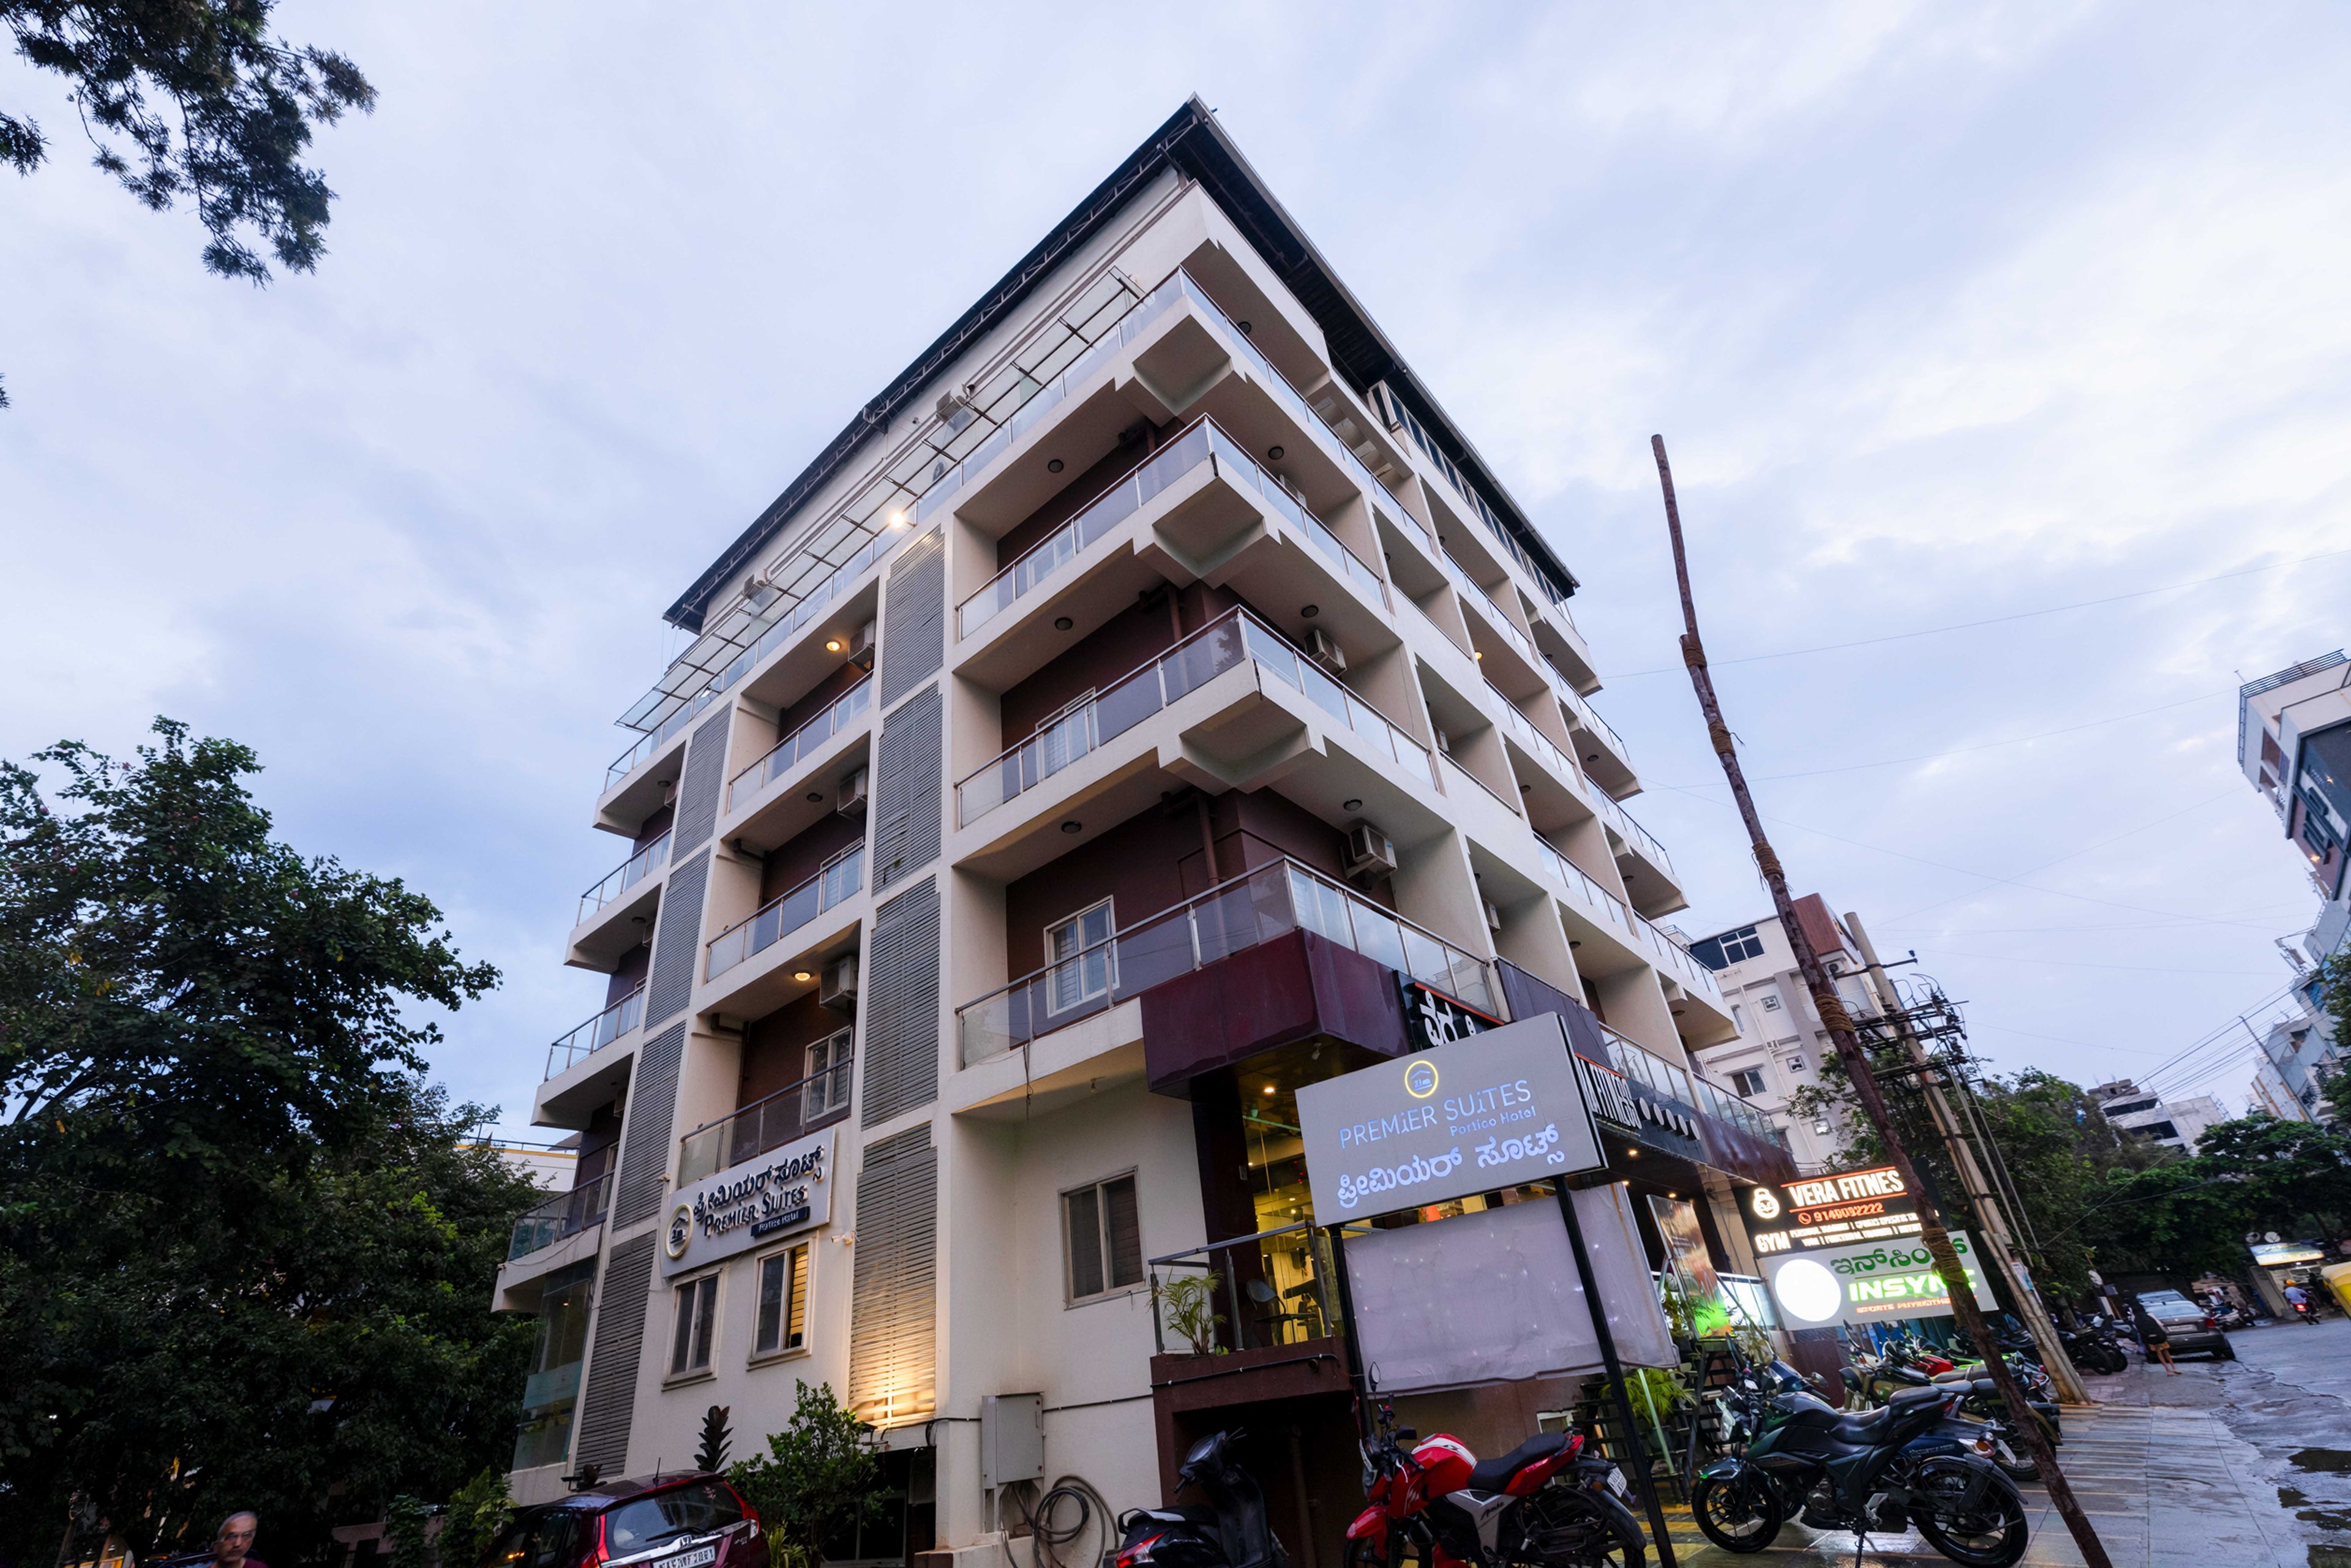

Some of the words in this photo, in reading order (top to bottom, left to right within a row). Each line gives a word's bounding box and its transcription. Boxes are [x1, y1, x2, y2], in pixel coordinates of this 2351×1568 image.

[1449, 1118, 1497, 1137] Portico
[1500, 1106, 1536, 1125] Hotel
[1788, 1180, 1840, 1207] VERA
[1755, 1231, 1791, 1253] GYM
